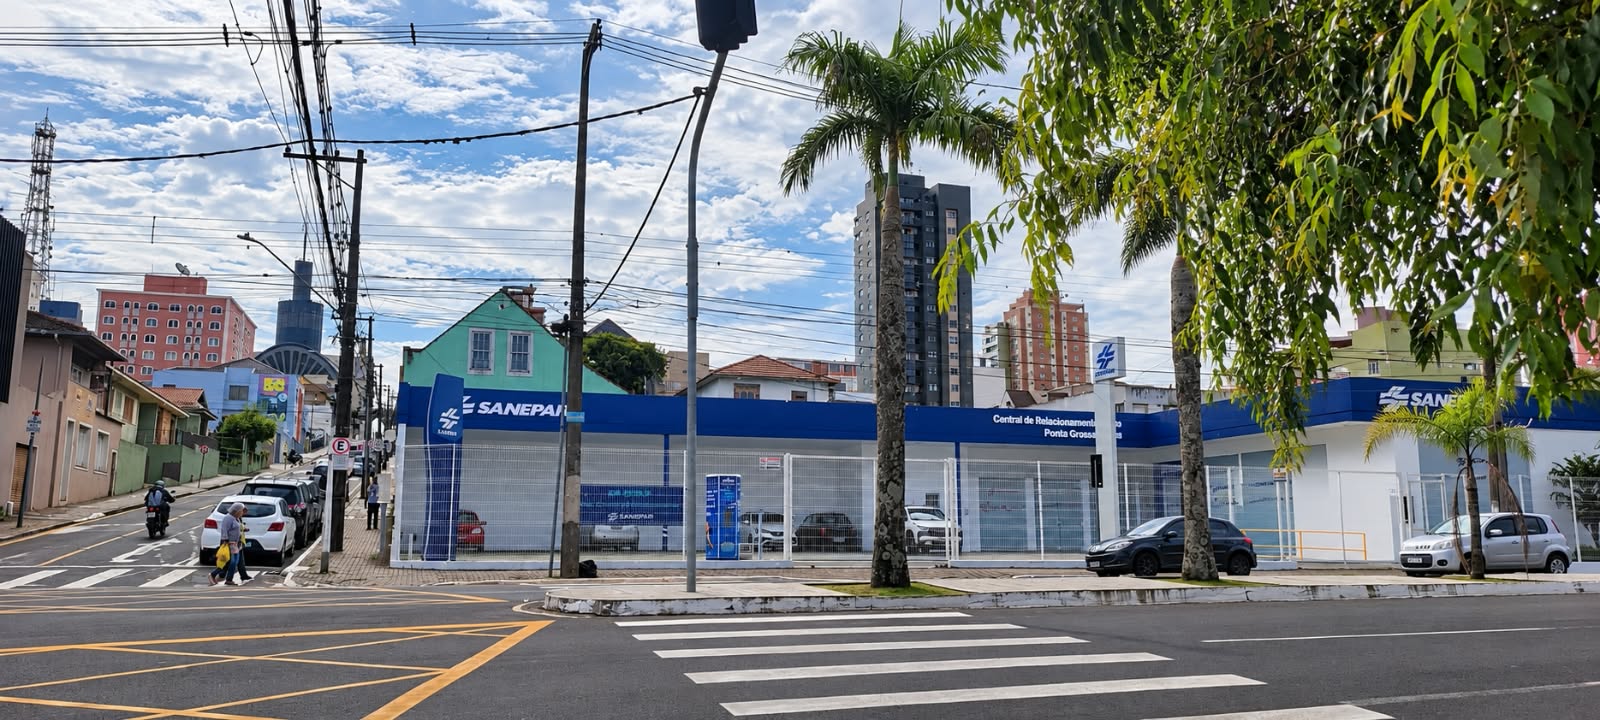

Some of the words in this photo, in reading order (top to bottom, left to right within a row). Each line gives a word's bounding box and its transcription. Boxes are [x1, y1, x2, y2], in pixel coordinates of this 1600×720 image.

[992, 414, 1022, 425] Central
[1023, 415, 1034, 425] de
[1035, 416, 1095, 428] Relacionament
[1044, 428, 1069, 439] Ponta
[336, 441, 345, 451] E
